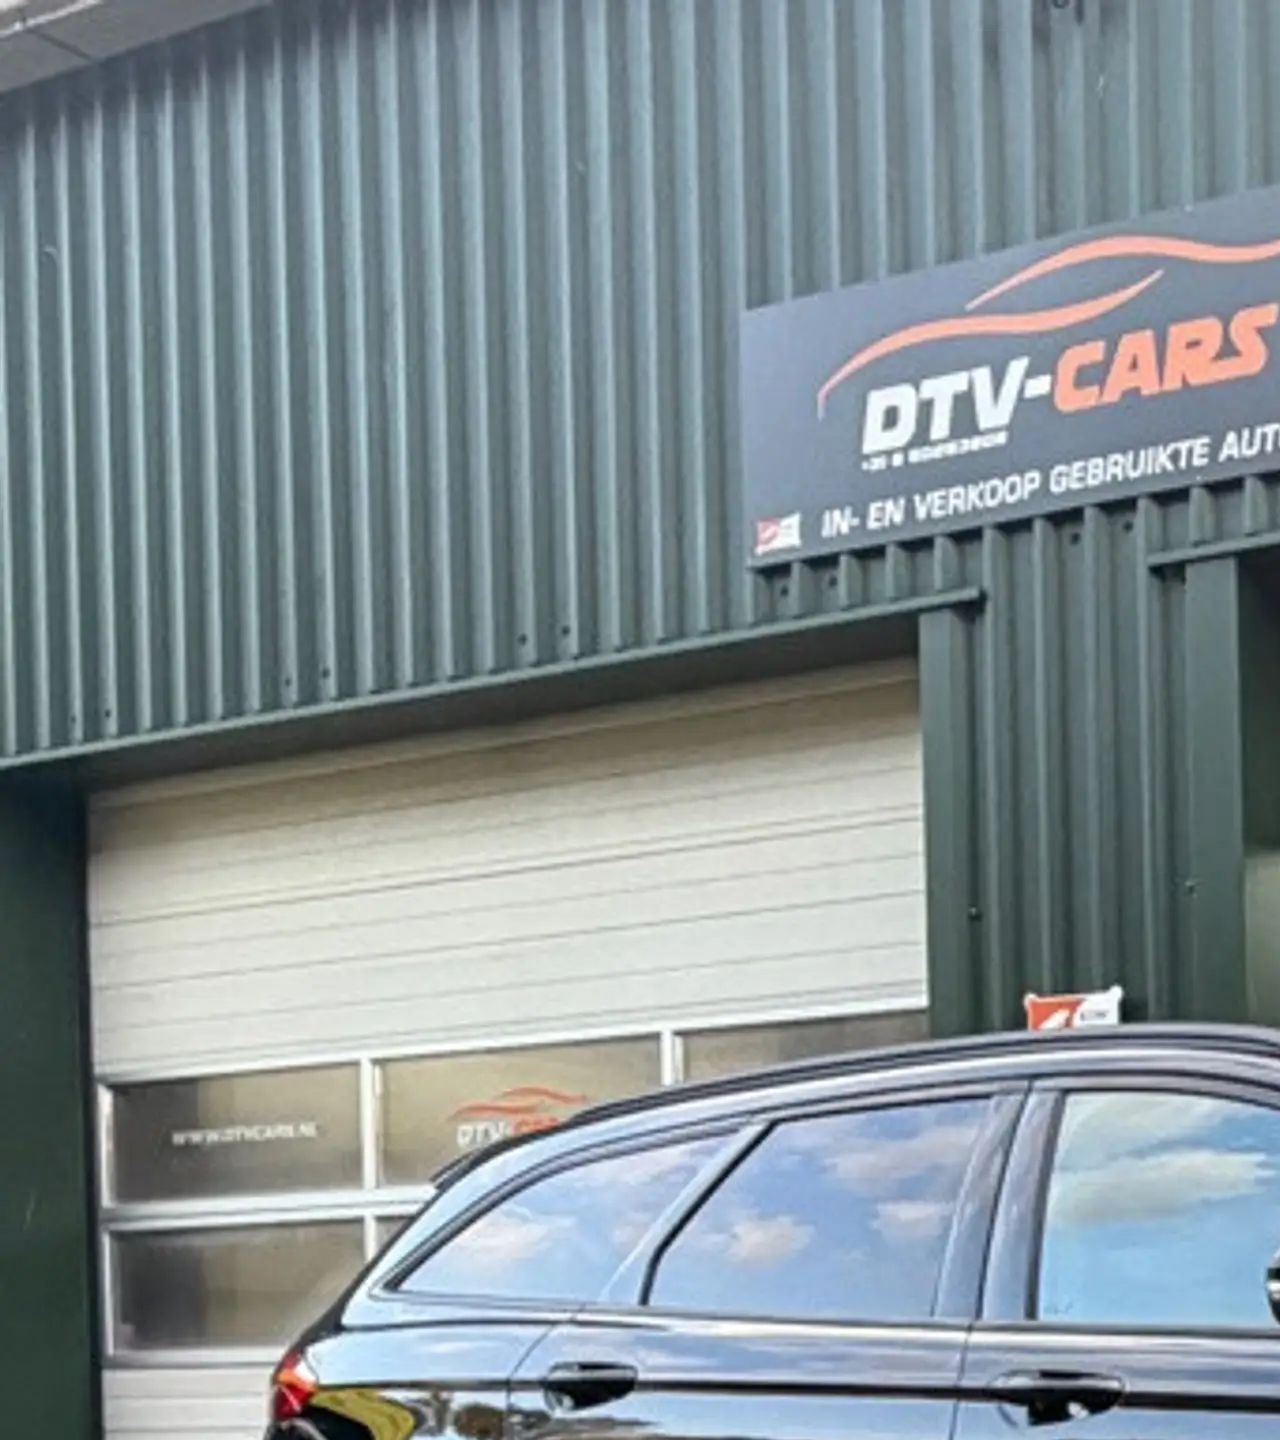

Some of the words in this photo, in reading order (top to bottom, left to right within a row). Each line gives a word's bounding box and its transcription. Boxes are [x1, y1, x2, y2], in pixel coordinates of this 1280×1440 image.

[861, 303, 1280, 456] DTV-CARS
[821, 504, 860, 538] IN-
[866, 497, 904, 530] EN
[914, 468, 1040, 522] VERKOOP
[1049, 435, 1211, 495] GEBRUIKTE
